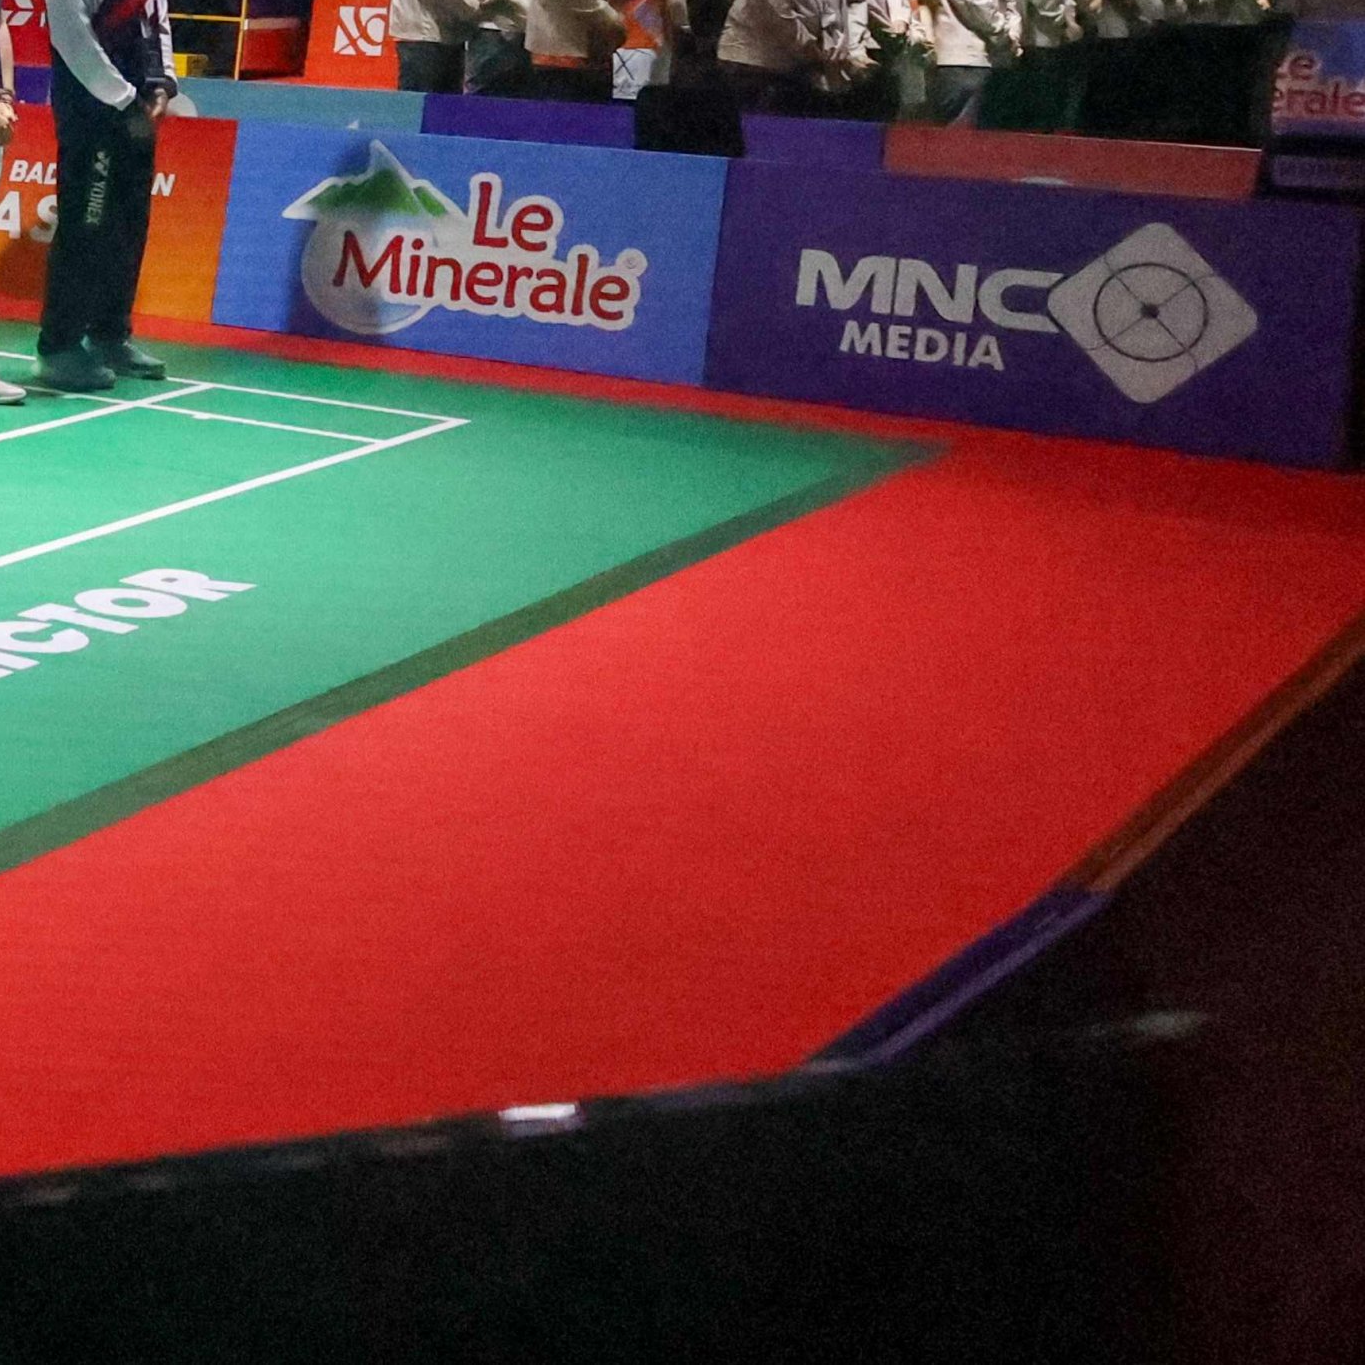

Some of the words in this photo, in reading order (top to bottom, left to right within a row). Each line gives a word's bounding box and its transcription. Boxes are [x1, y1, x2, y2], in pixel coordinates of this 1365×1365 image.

[85, 181, 107, 226] YONEX
[472, 181, 554, 252] Le
[332, 230, 631, 321] Minerale
[796, 248, 1066, 333] MNC
[838, 320, 1005, 371] MEDIA
